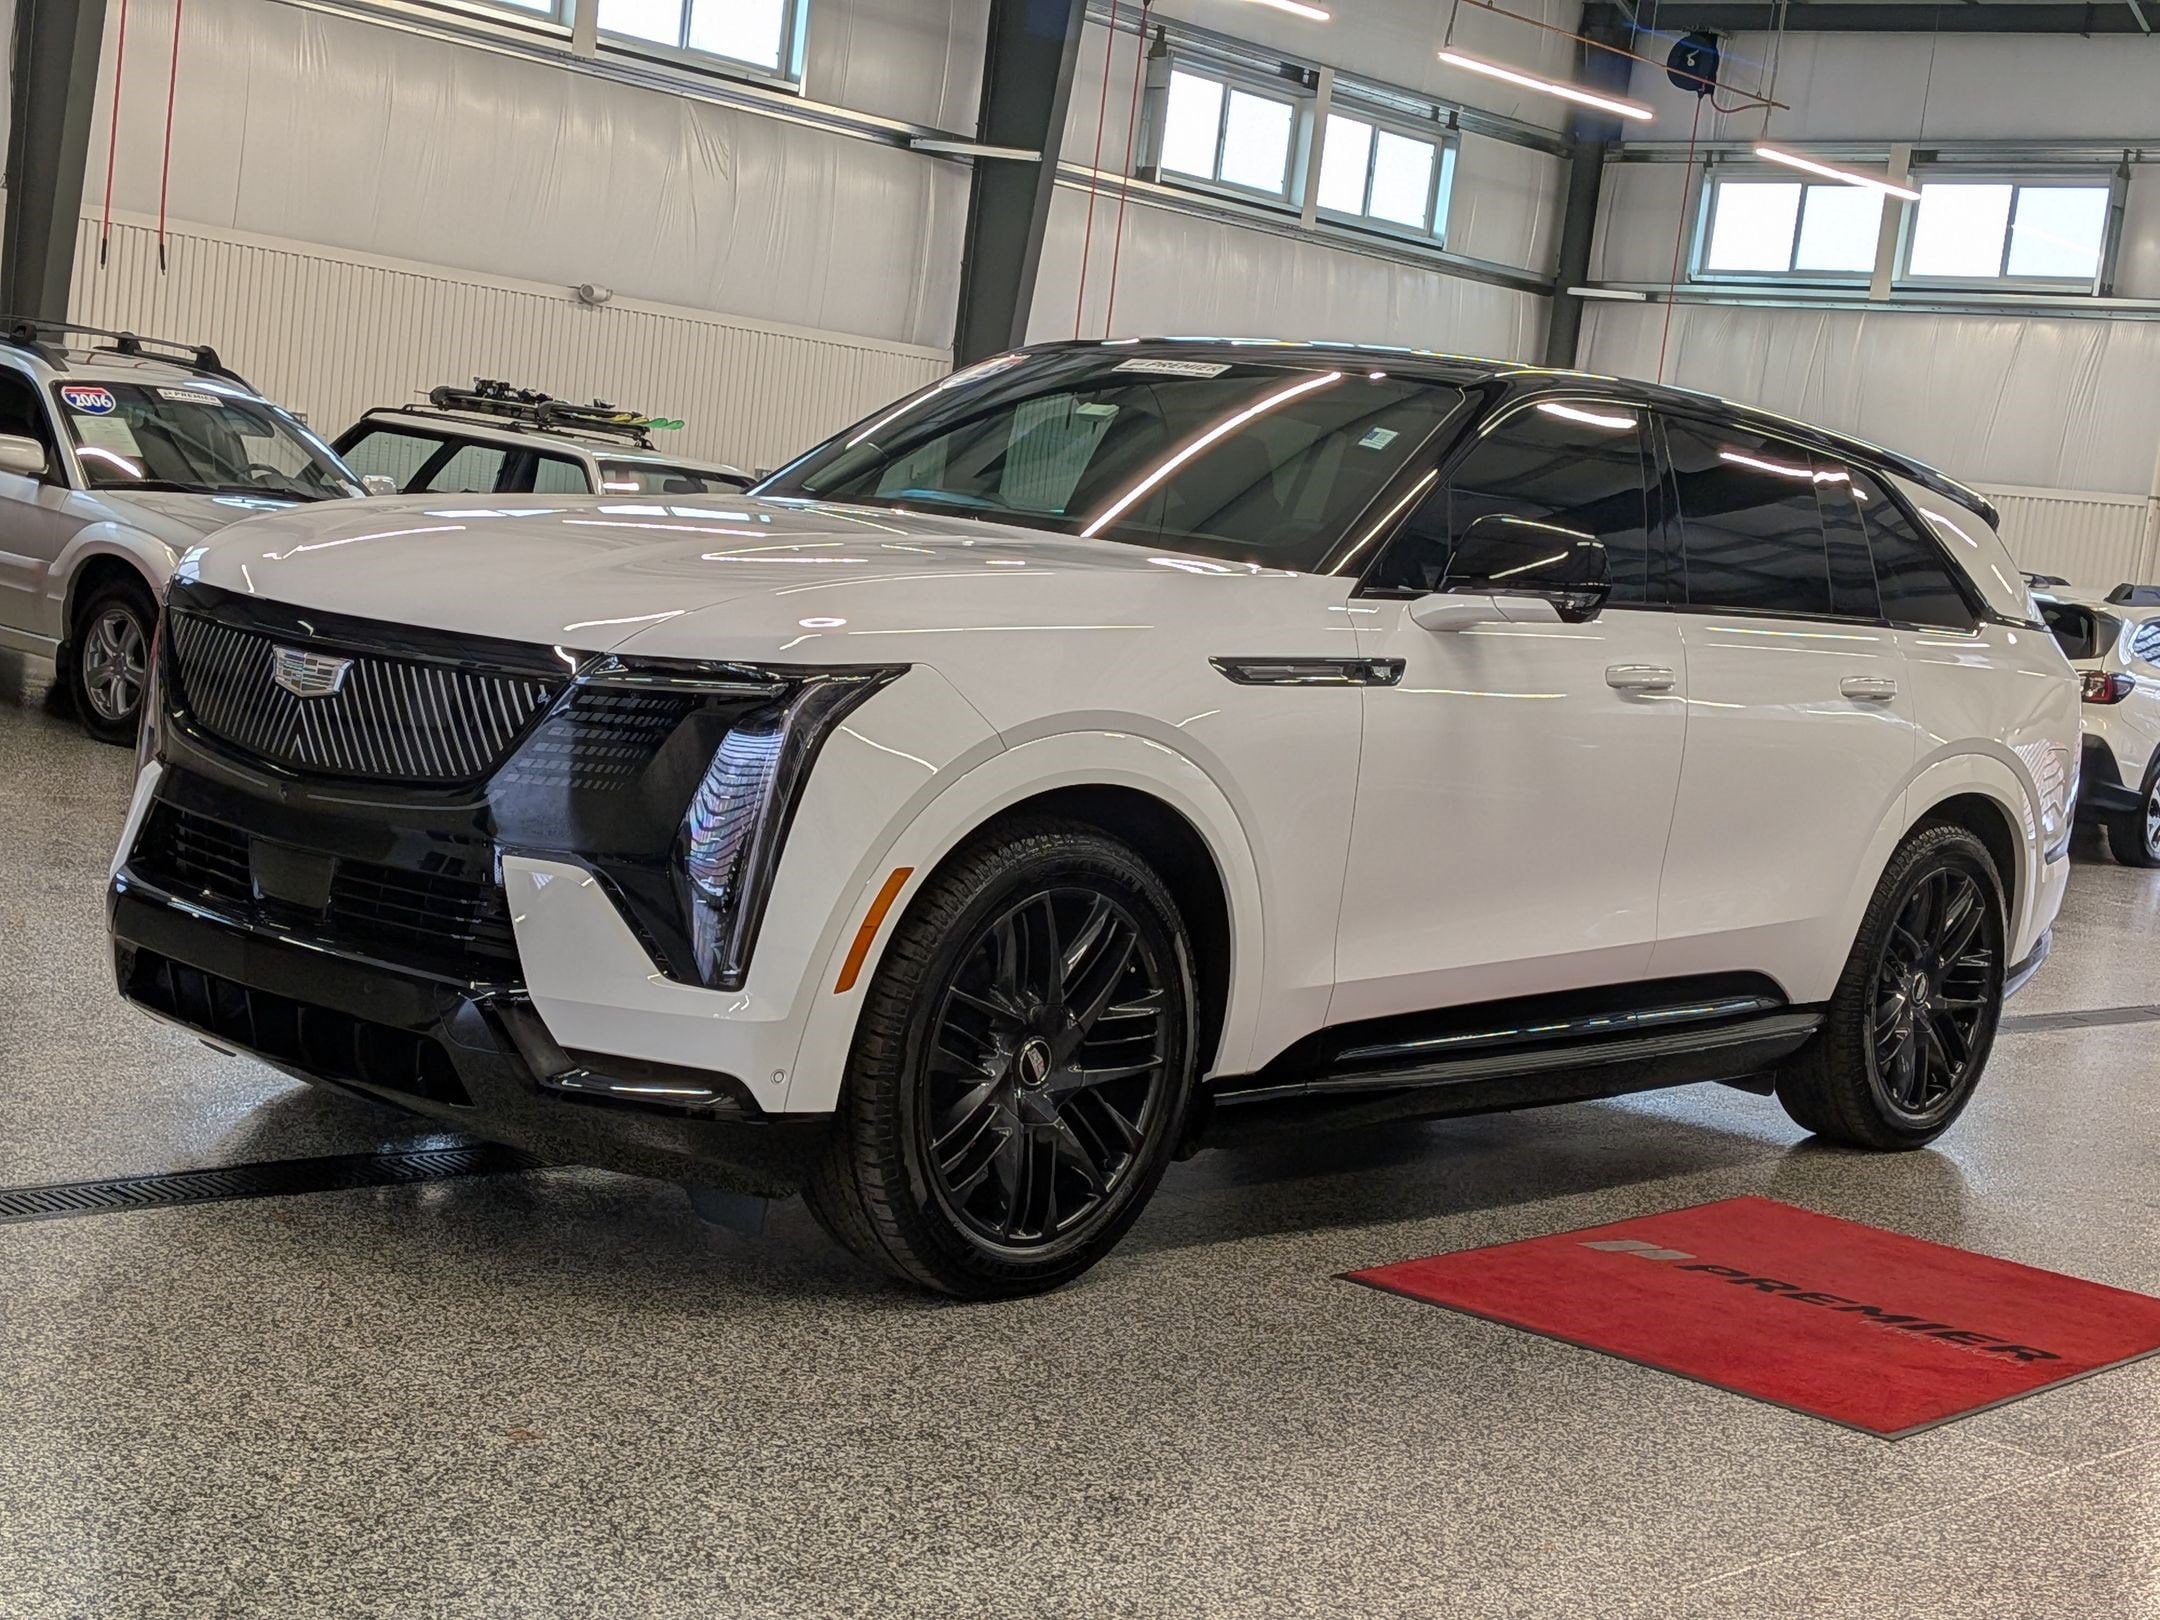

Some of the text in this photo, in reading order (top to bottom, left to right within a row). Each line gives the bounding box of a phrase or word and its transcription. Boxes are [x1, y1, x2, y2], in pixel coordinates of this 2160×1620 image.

[1146, 361, 1224, 372] PREMIER
[72, 393, 112, 408] 2006
[1674, 1264, 2061, 1361] PREMIER
